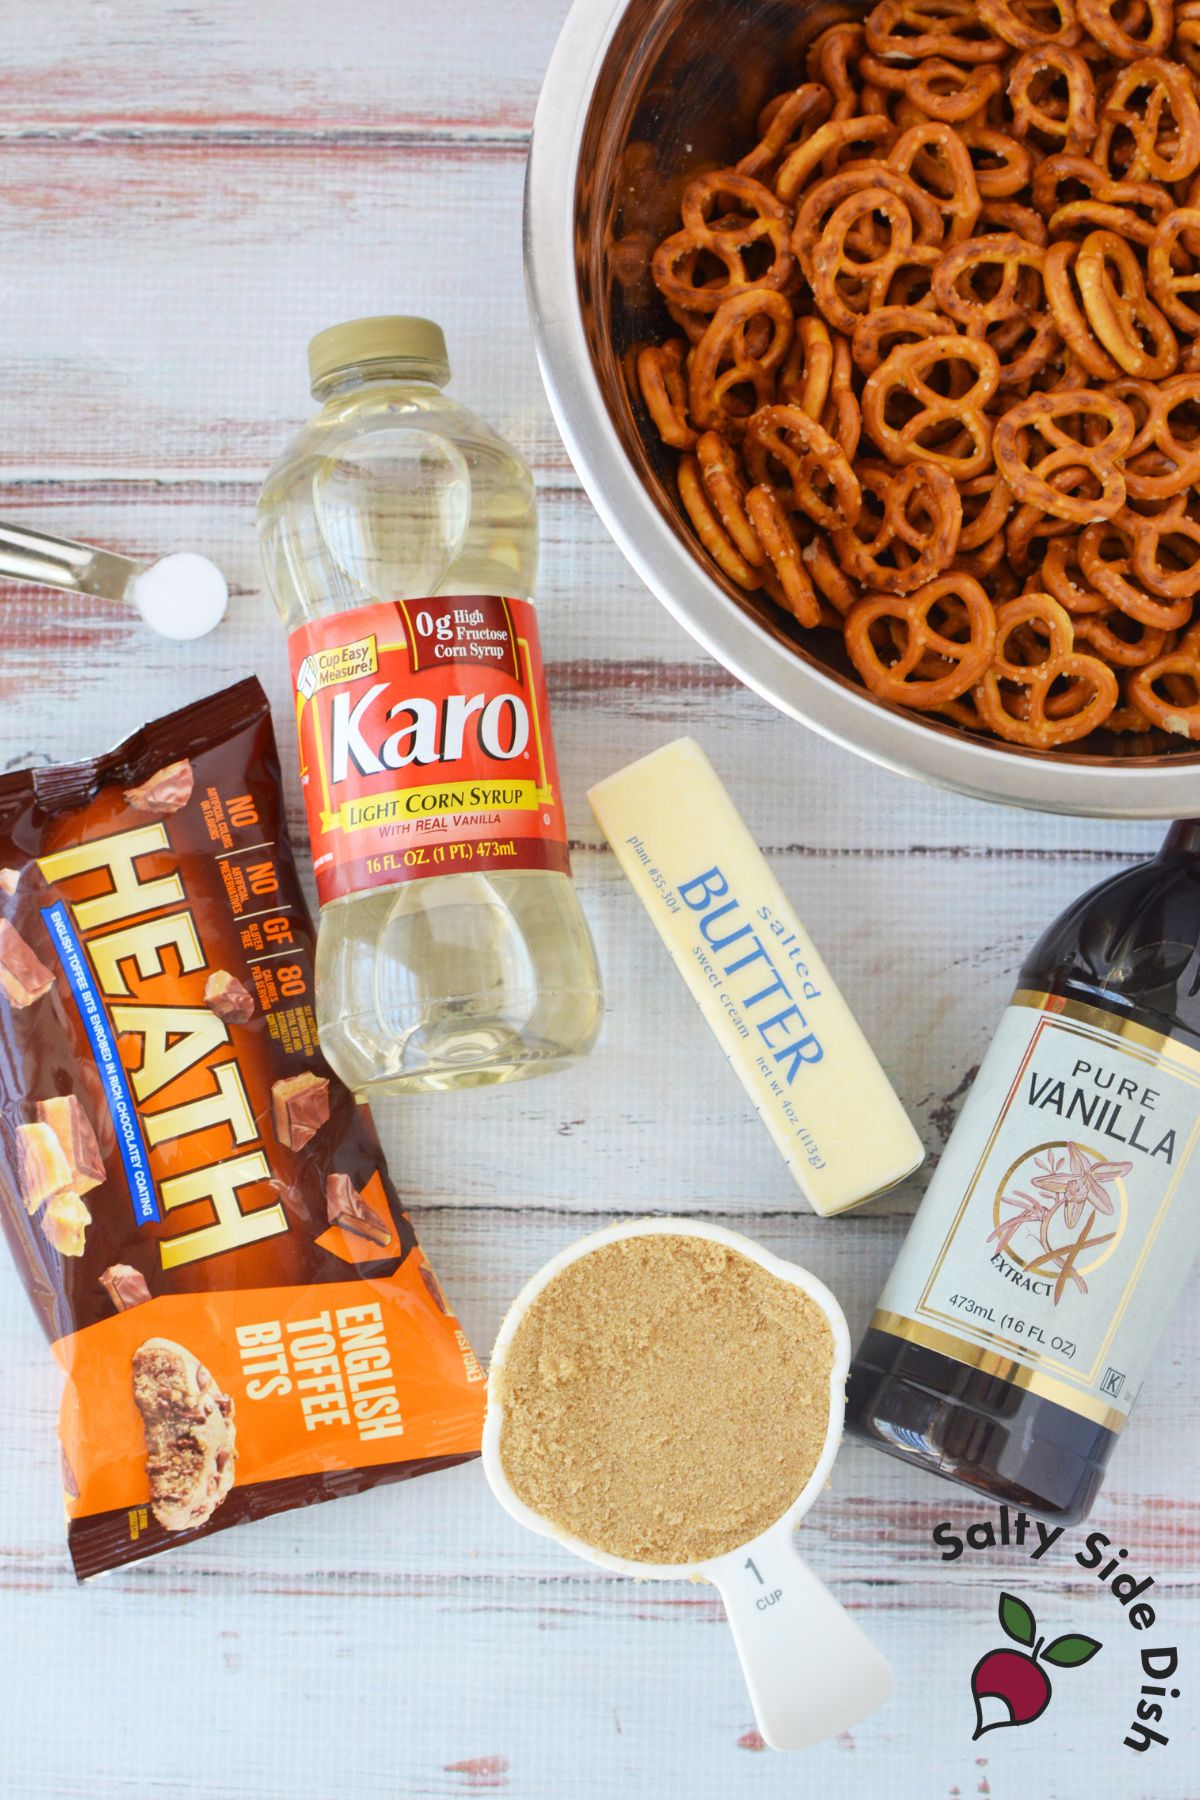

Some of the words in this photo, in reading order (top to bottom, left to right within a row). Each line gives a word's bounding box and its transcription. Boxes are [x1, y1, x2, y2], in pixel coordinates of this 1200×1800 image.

[416, 611, 453, 639] 0g
[455, 610, 484, 626] High
[457, 626, 508, 642] Fructose
[319, 652, 340, 671] Cup
[341, 645, 369, 663] Easy
[435, 644, 467, 658] Corn
[470, 643, 504, 659] Syrup
[319, 660, 373, 685] Measure!
[331, 682, 530, 784] Karo
[207, 787, 224, 821] ARTIFICIAL
[219, 822, 233, 849] COLORS
[226, 795, 258, 828] NO
[350, 800, 400, 826] LIGHT
[406, 789, 464, 813] CORN
[470, 787, 523, 805] SYRUP
[203, 811, 218, 840] FLAVORS
[378, 823, 410, 838] WITH
[415, 818, 448, 831] REAL
[453, 814, 501, 827] VANILLA
[367, 858, 380, 874] 16
[383, 854, 401, 870] FL.
[405, 850, 429, 866] OZ.
[433, 844, 446, 863] (1
[450, 843, 473, 860] PT.)
[476, 841, 517, 857] 473mL
[626, 834, 650, 867] plant
[219, 860, 243, 914] PRESERVATIVES
[231, 866, 249, 903] ARTIFICIAL
[246, 861, 278, 895] NO
[50, 911, 74, 954] ENGLISH
[240, 930, 253, 949] FREE
[249, 923, 264, 950] GLUTEN
[264, 917, 294, 944] GF
[758, 907, 820, 1000] salted
[67, 953, 89, 991] TOFFEE
[251, 965, 263, 980] PER
[262, 969, 278, 1003] CALORIES
[276, 964, 306, 997] 80
[677, 866, 824, 1086] BUTTER
[82, 991, 98, 1014] BITS
[254, 979, 272, 1010] SERVING
[693, 945, 721, 990] sweet
[720, 993, 750, 1039] cream
[35, 821, 290, 1271] HEATH
[90, 1014, 112, 1062] ENROBED
[105, 1062, 116, 1074] IN
[1071, 1059, 1161, 1111] PURE
[108, 1075, 124, 1100] RICH
[757, 1056, 773, 1076] net
[769, 1076, 784, 1097] wt
[782, 1099, 798, 1125] 4oz
[796, 1127, 826, 1170] (113g)
[1028, 1072, 1177, 1165] VANILLA
[116, 1101, 143, 1169] CHOCOLATEY
[133, 1170, 153, 1216] COATING
[989, 1252, 1054, 1298] EXTRACT
[949, 1293, 996, 1324] 473mL
[1000, 1313, 1025, 1334] (16
[1027, 1323, 1046, 1344] FL
[1050, 1332, 1076, 1359] OZ)
[235, 1320, 293, 1401] BITS
[286, 1311, 351, 1431] TOFFEE
[335, 1303, 403, 1441] ENGLISH
[744, 1557, 765, 1585] 1
[755, 1588, 784, 1611] CUP
